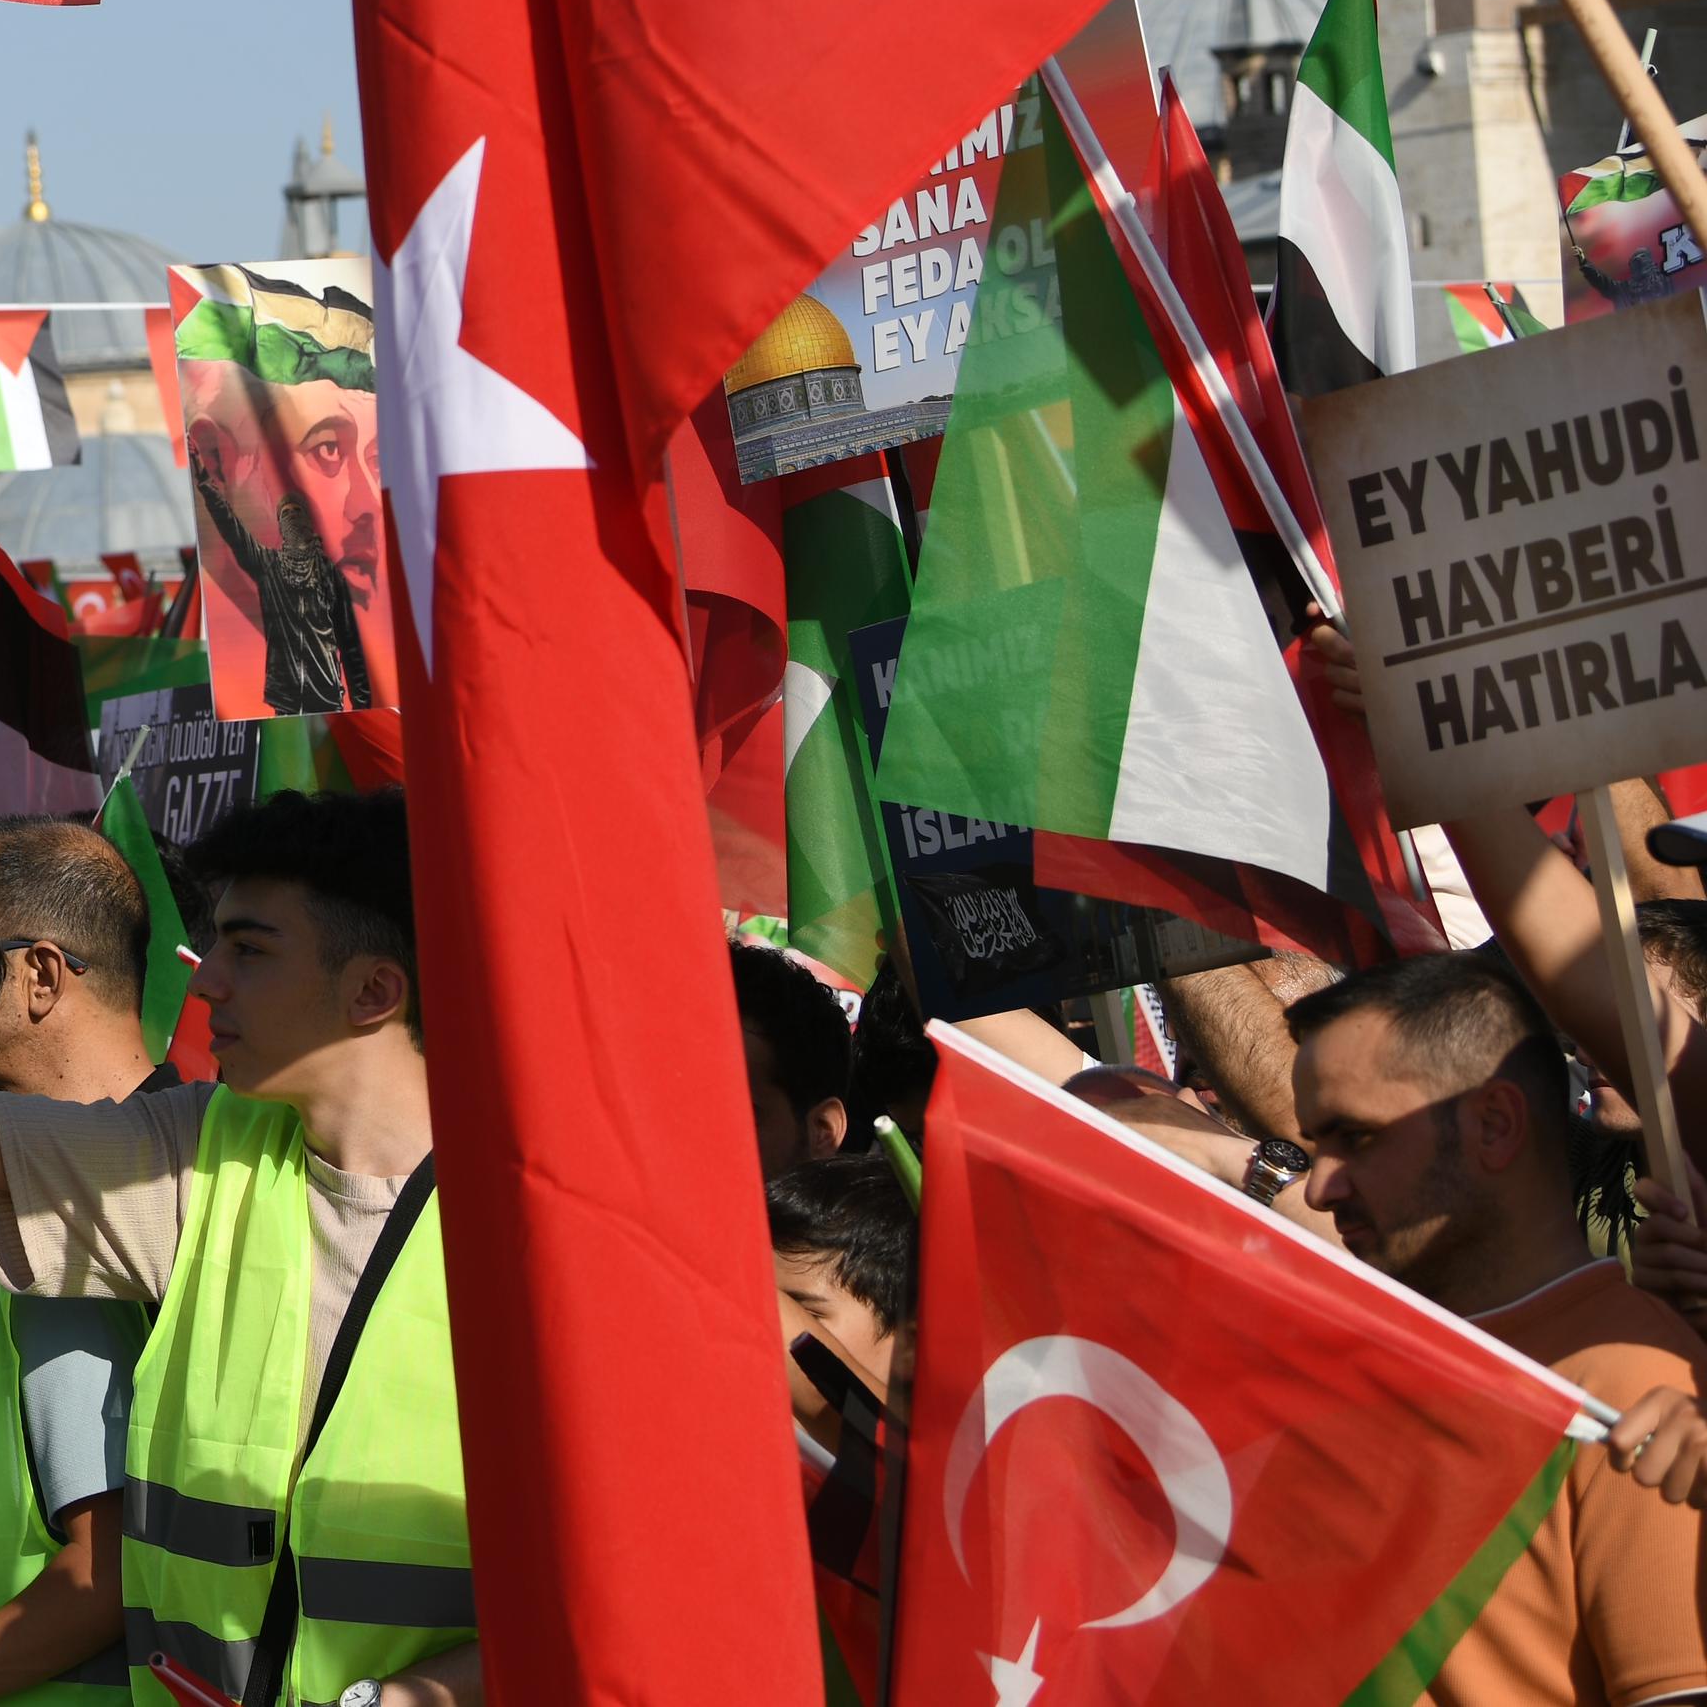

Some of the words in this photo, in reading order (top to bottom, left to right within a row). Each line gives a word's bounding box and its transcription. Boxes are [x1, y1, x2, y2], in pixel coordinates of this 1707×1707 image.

[852, 176, 987, 257] SANA
[861, 237, 985, 315] FEDA
[872, 308, 936, 373] EY
[1347, 457, 1429, 549] EY
[1427, 365, 1701, 521] YAHUDİ
[1392, 483, 1687, 648] HAYBERİ
[1416, 617, 1707, 752] HATIRLA
